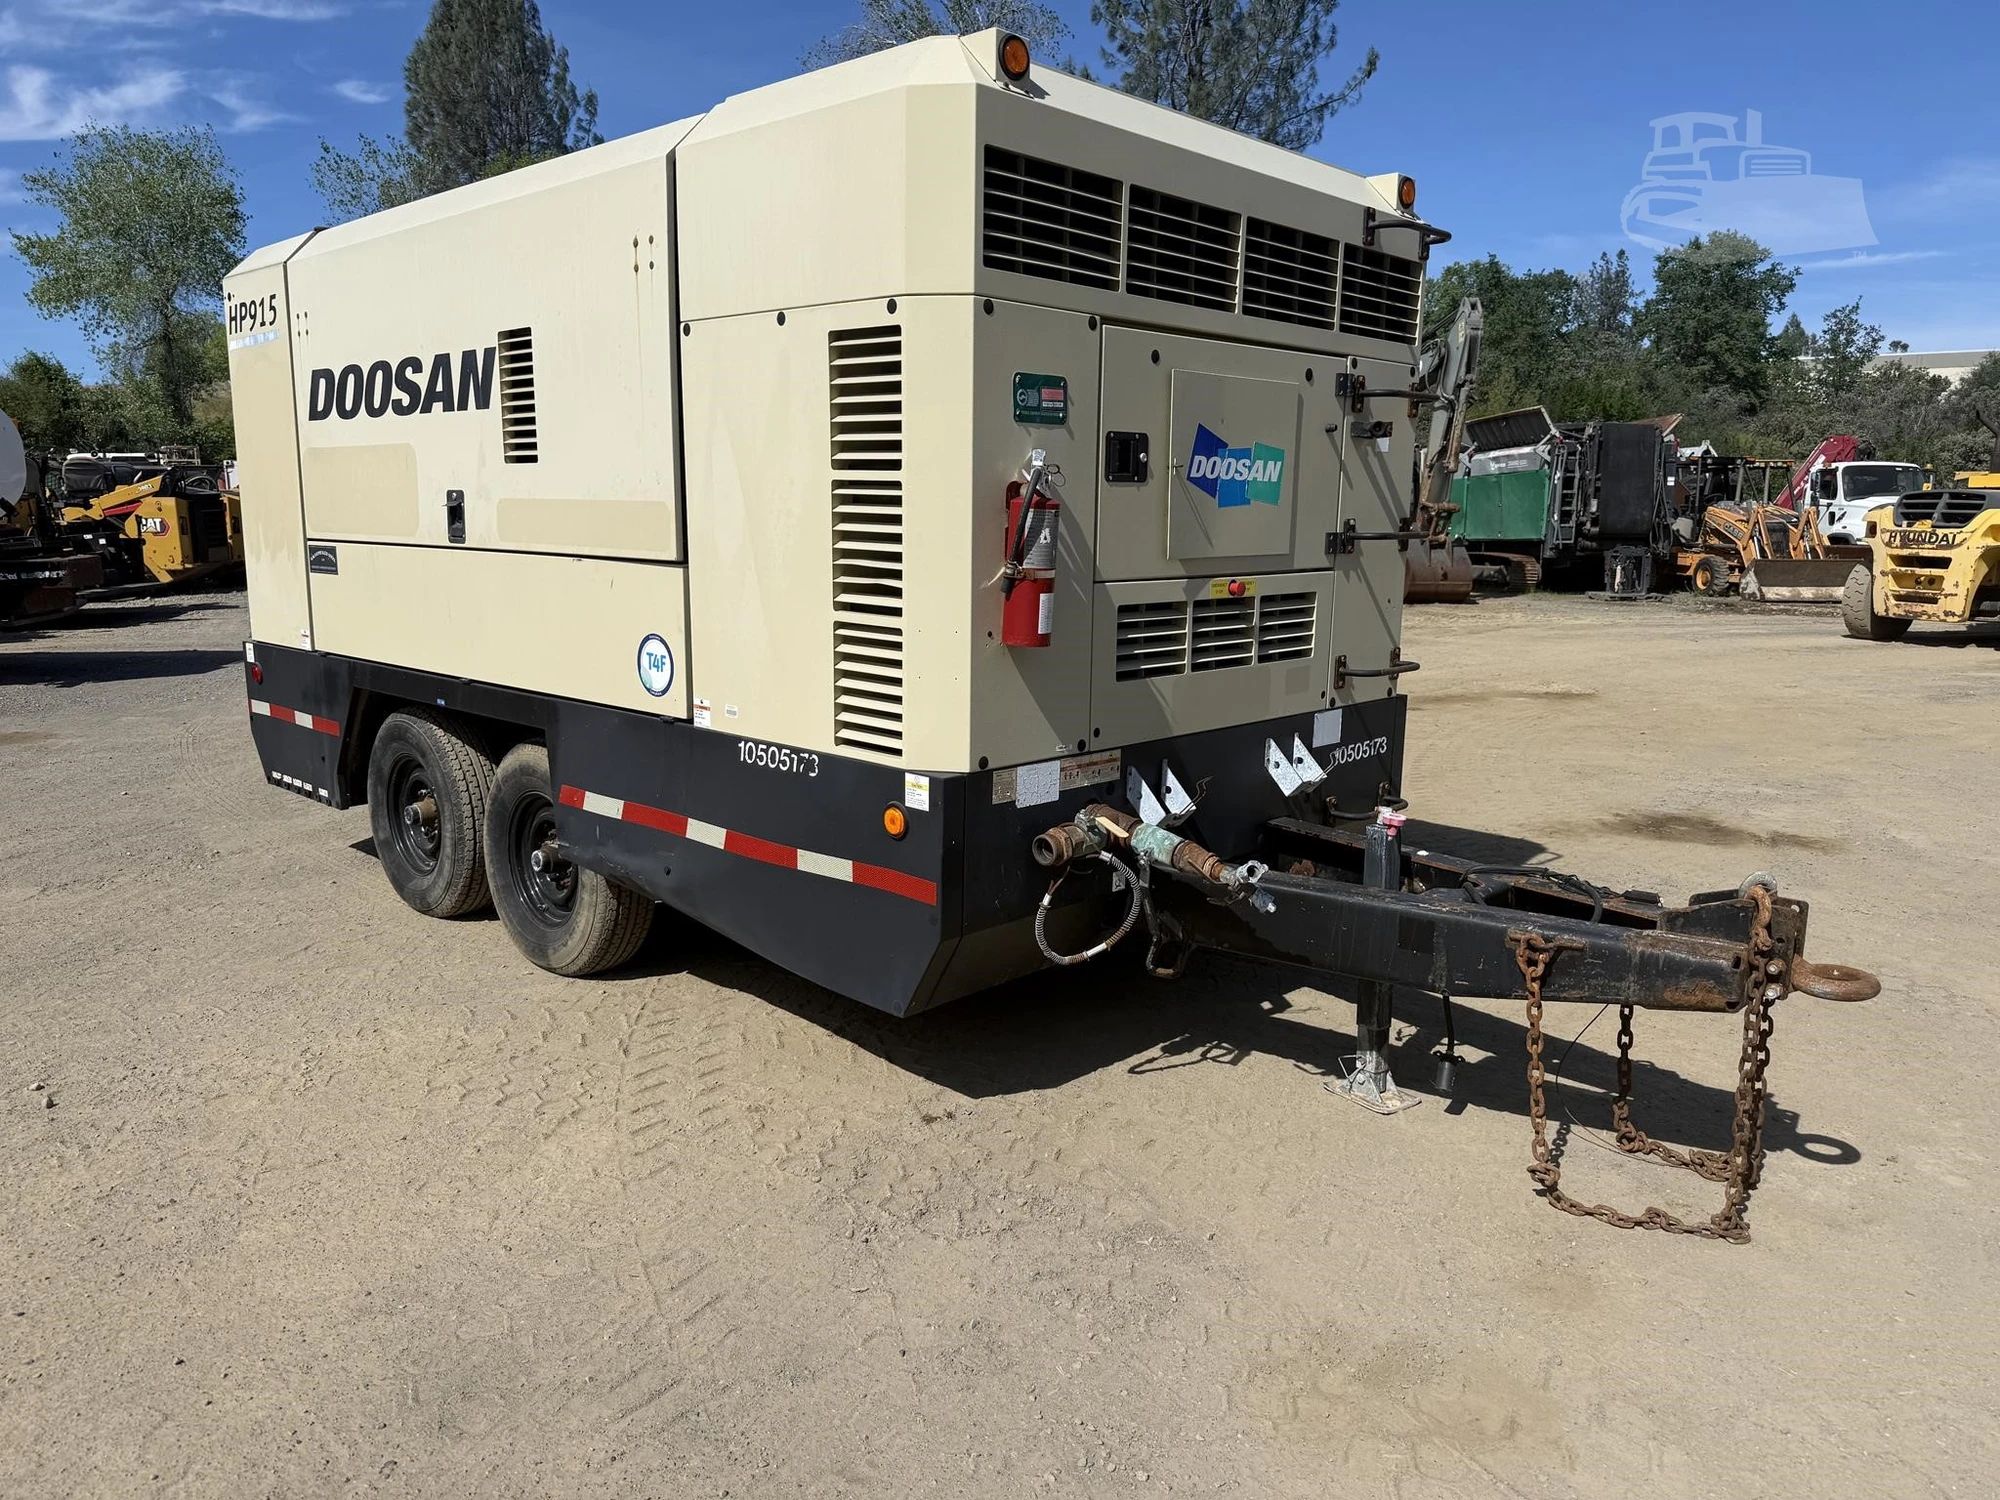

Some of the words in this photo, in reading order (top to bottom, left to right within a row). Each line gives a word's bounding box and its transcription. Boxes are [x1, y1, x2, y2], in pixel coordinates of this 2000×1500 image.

[229, 294, 277, 335] HP915
[308, 346, 497, 421] DOOSAN
[1190, 455, 1282, 482] DOOSAN
[140, 518, 162, 532] CAT
[1888, 530, 1957, 545] HYUNDAI
[646, 652, 666, 672] T4F
[738, 741, 819, 777] 10505173
